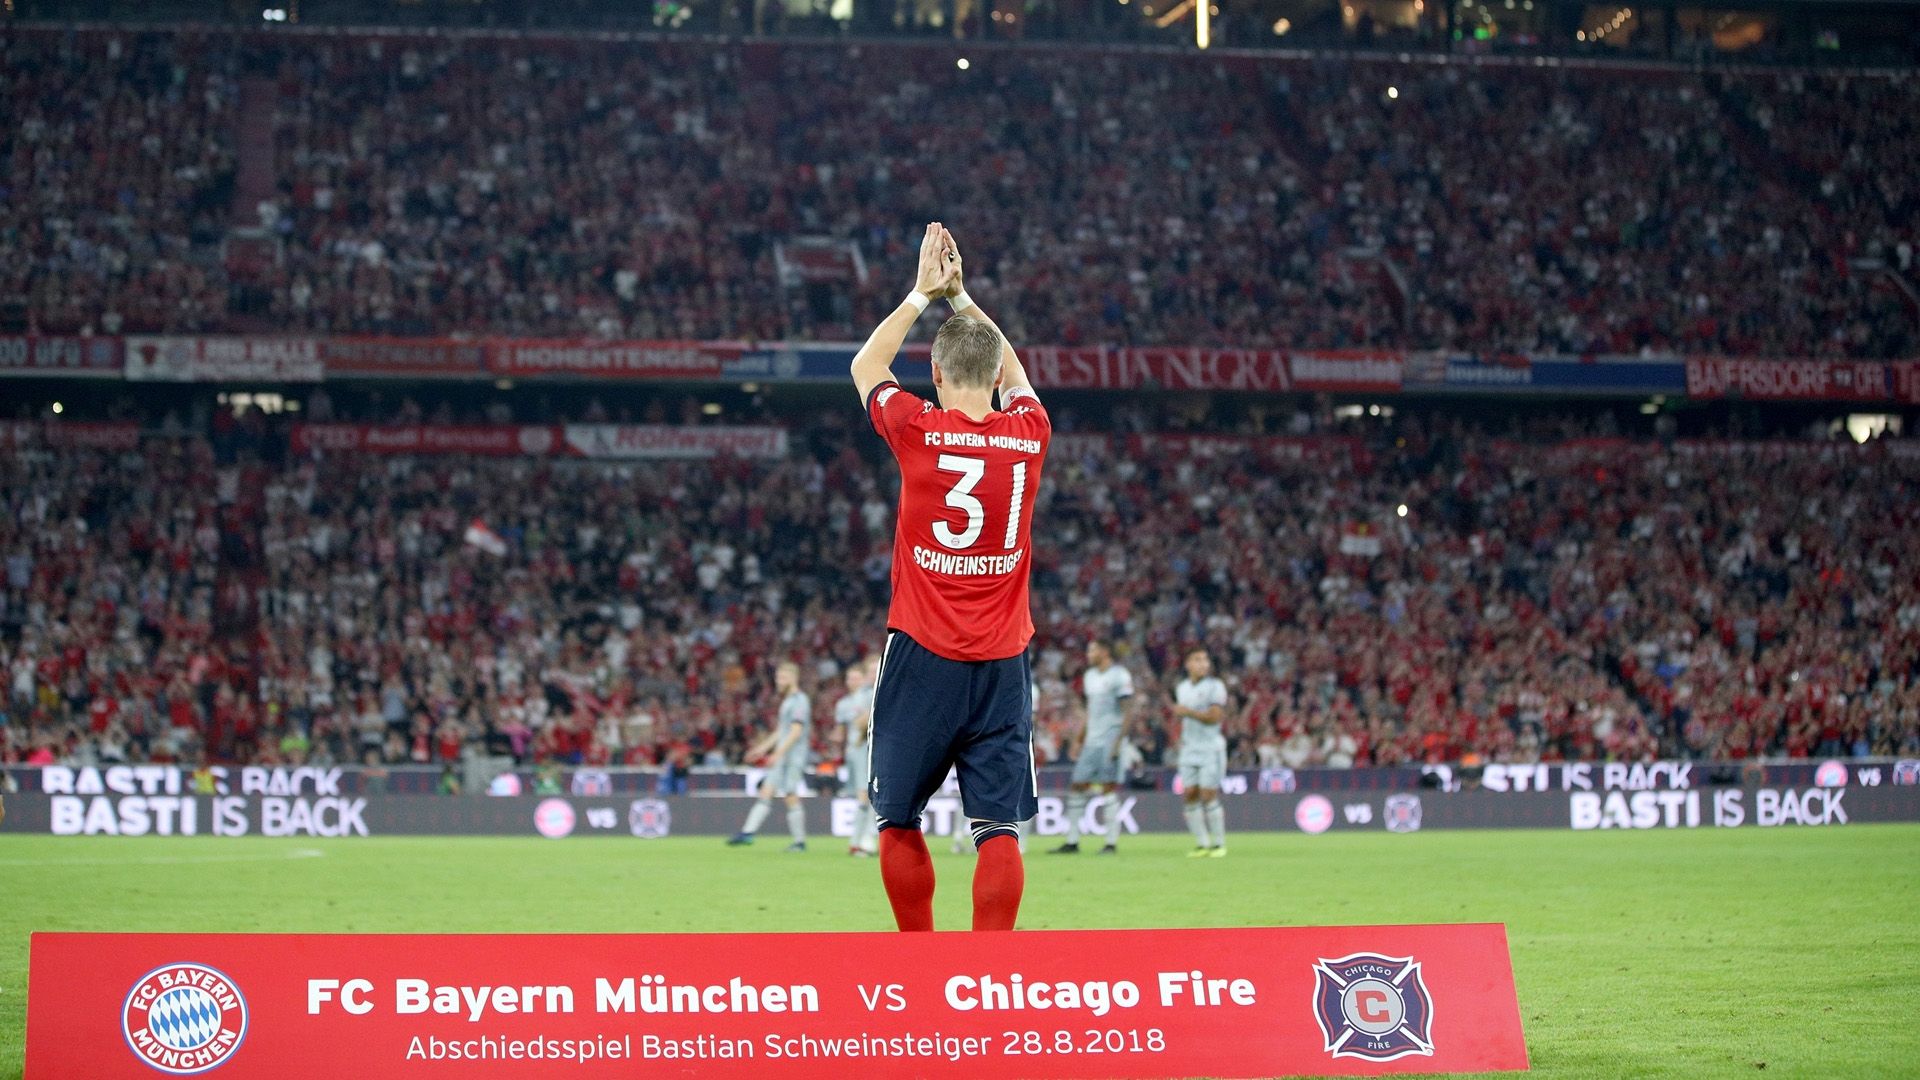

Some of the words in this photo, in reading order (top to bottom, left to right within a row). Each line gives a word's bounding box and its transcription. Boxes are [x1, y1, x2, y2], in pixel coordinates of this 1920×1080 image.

[1027, 347, 1152, 388] BESTIA
[1163, 349, 1292, 391] NEGRA
[924, 431, 941, 446] FC
[944, 431, 986, 448] BAYERN
[931, 453, 1027, 551] 31
[50, 796, 197, 837] BASTI
[212, 796, 249, 838] IS
[260, 796, 369, 838] BACK
[1569, 790, 1701, 830] BASTI
[1714, 789, 1745, 828] IS
[1757, 787, 1848, 827] BACK
[133, 984, 157, 1011] FC
[157, 969, 238, 1011] BAYERN
[1344, 964, 1392, 978] CHICAGO
[306, 978, 375, 1015] FC
[395, 978, 574, 1021] Bayern
[595, 973, 819, 1014] München
[944, 973, 1140, 1017] Chicago
[1157, 969, 1256, 1007] Fire
[1355, 990, 1390, 1023] C
[132, 1028, 238, 1068] MÜNCHEN
[406, 1034, 630, 1064] Abschiedsspiel
[642, 1034, 754, 1060] Bastian
[764, 1031, 992, 1062] Schweinsteiger
[1002, 1028, 1166, 1056] 28.8.2018
[1367, 1041, 1391, 1050] FIRE
